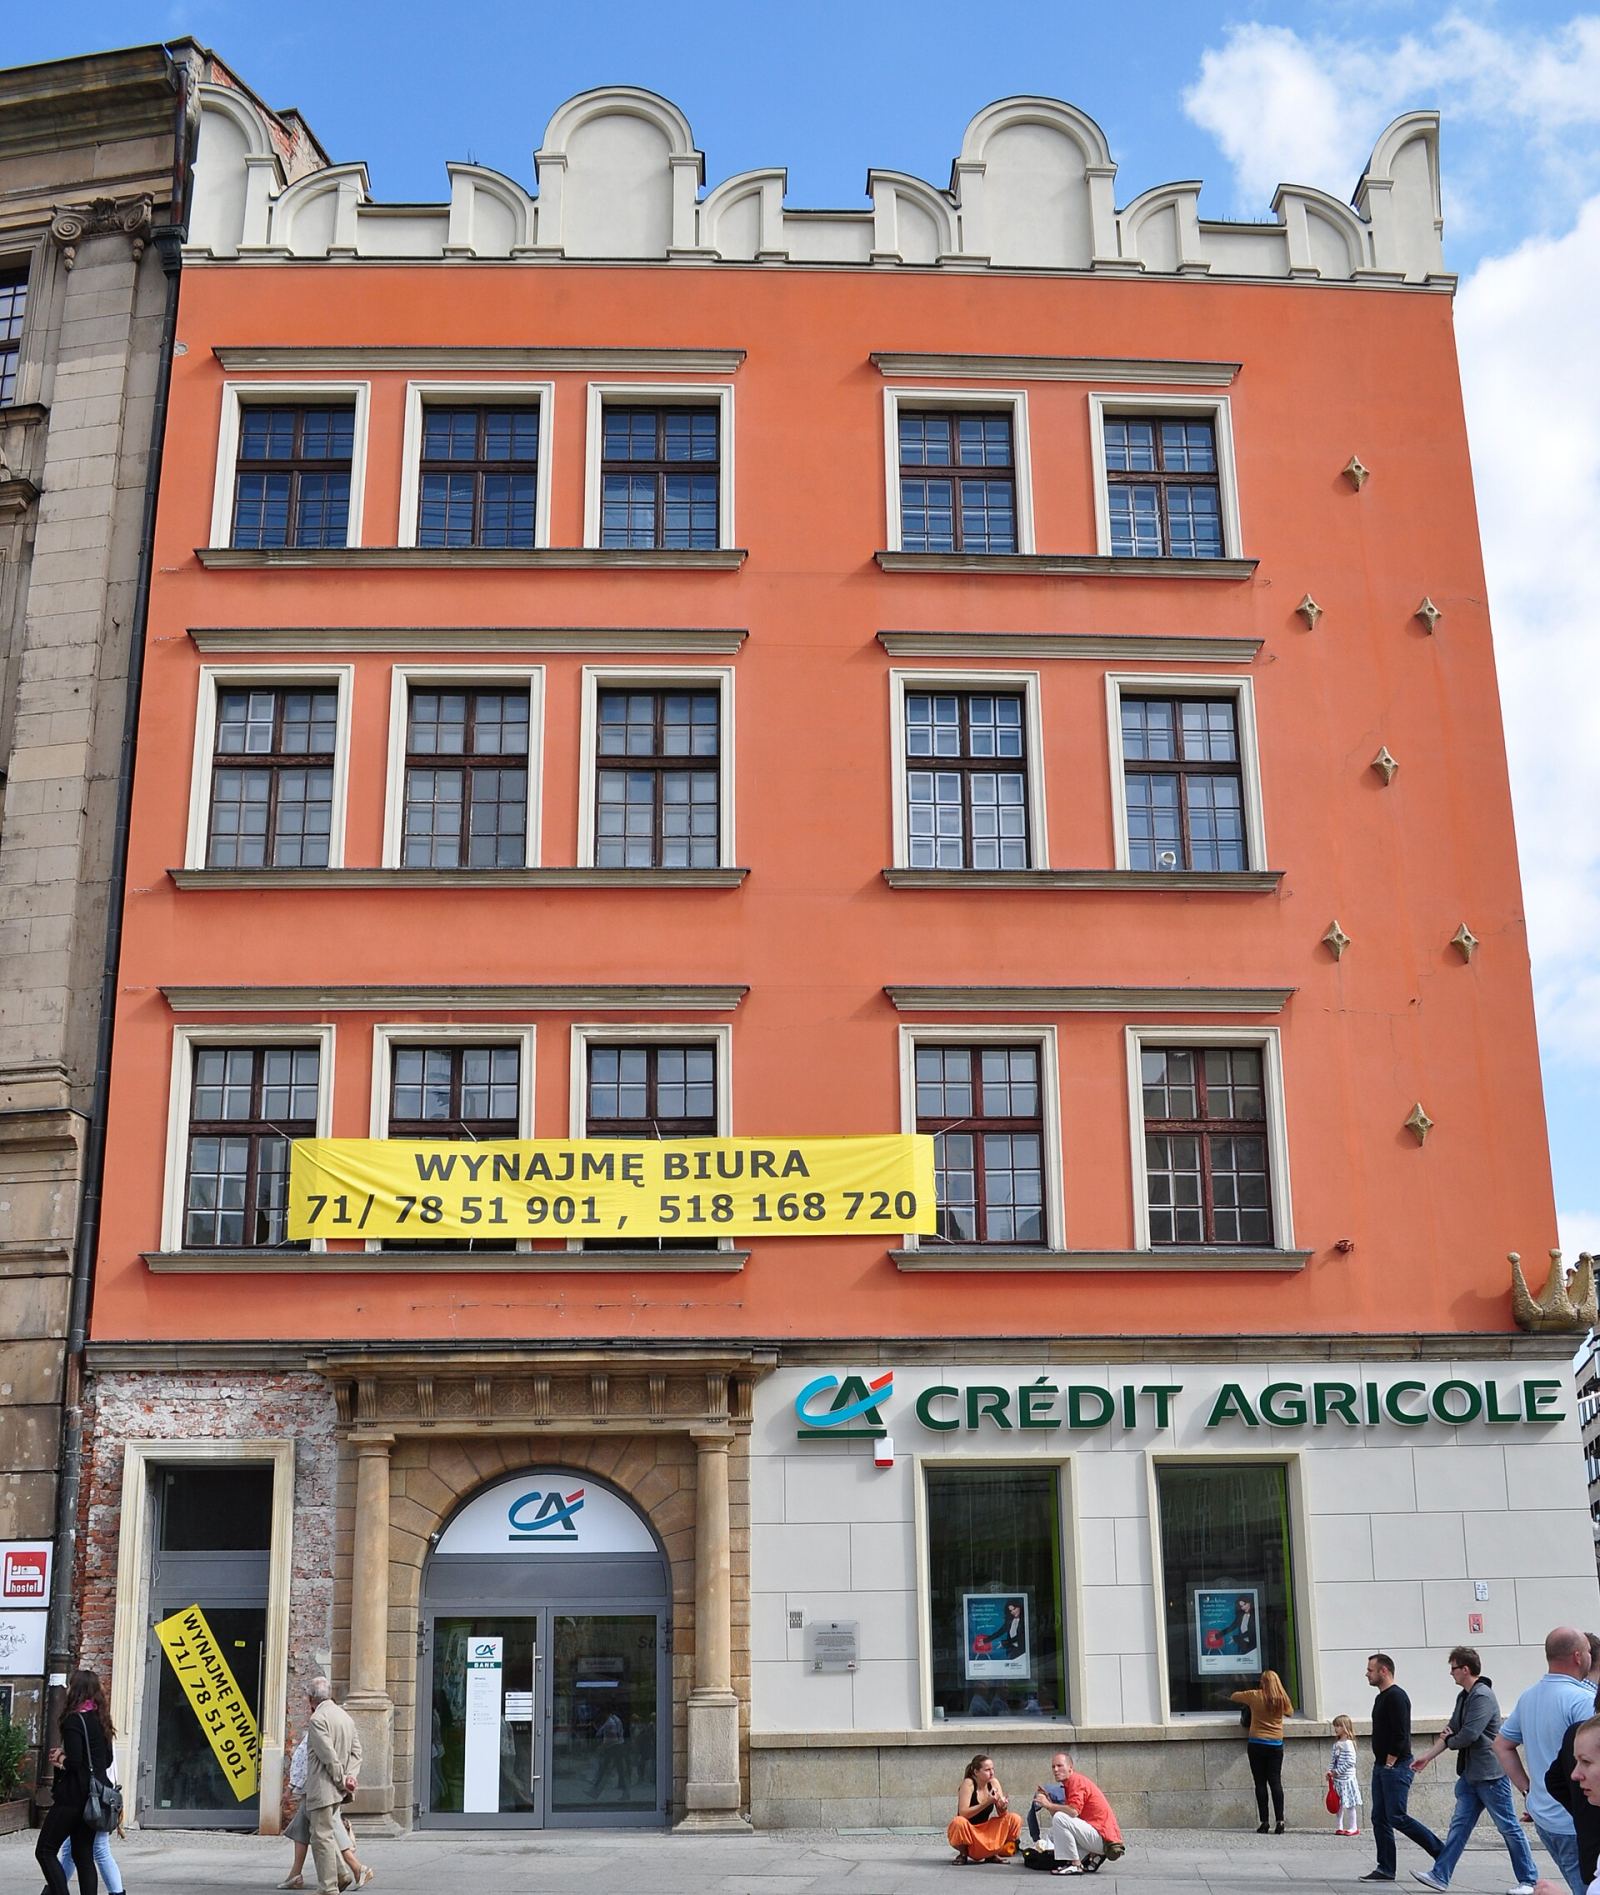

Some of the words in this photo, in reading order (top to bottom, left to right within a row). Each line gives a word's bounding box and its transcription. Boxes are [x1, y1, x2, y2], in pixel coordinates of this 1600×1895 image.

[415, 1152, 645, 1187] WYNAJMĘ
[664, 1149, 810, 1180] BIURA
[307, 1194, 375, 1229] 71/
[395, 1195, 443, 1224] 78
[460, 1196, 508, 1224] 51
[526, 1196, 600, 1224] 901
[659, 1195, 734, 1223] 518
[752, 1193, 826, 1222] 168
[842, 1190, 917, 1220] 720
[915, 1376, 1183, 1430] CRÉDIT
[1205, 1379, 1566, 1428] AGRICOLE
[12, 1583, 37, 1593] hostel
[170, 1636, 197, 1670] 71/
[190, 1677, 211, 1704] 78
[205, 1709, 225, 1735] 51
[220, 1740, 247, 1778] 901
[183, 1612, 234, 1702] WYNAJMĘ
[226, 1701, 257, 1768] PIWNI
